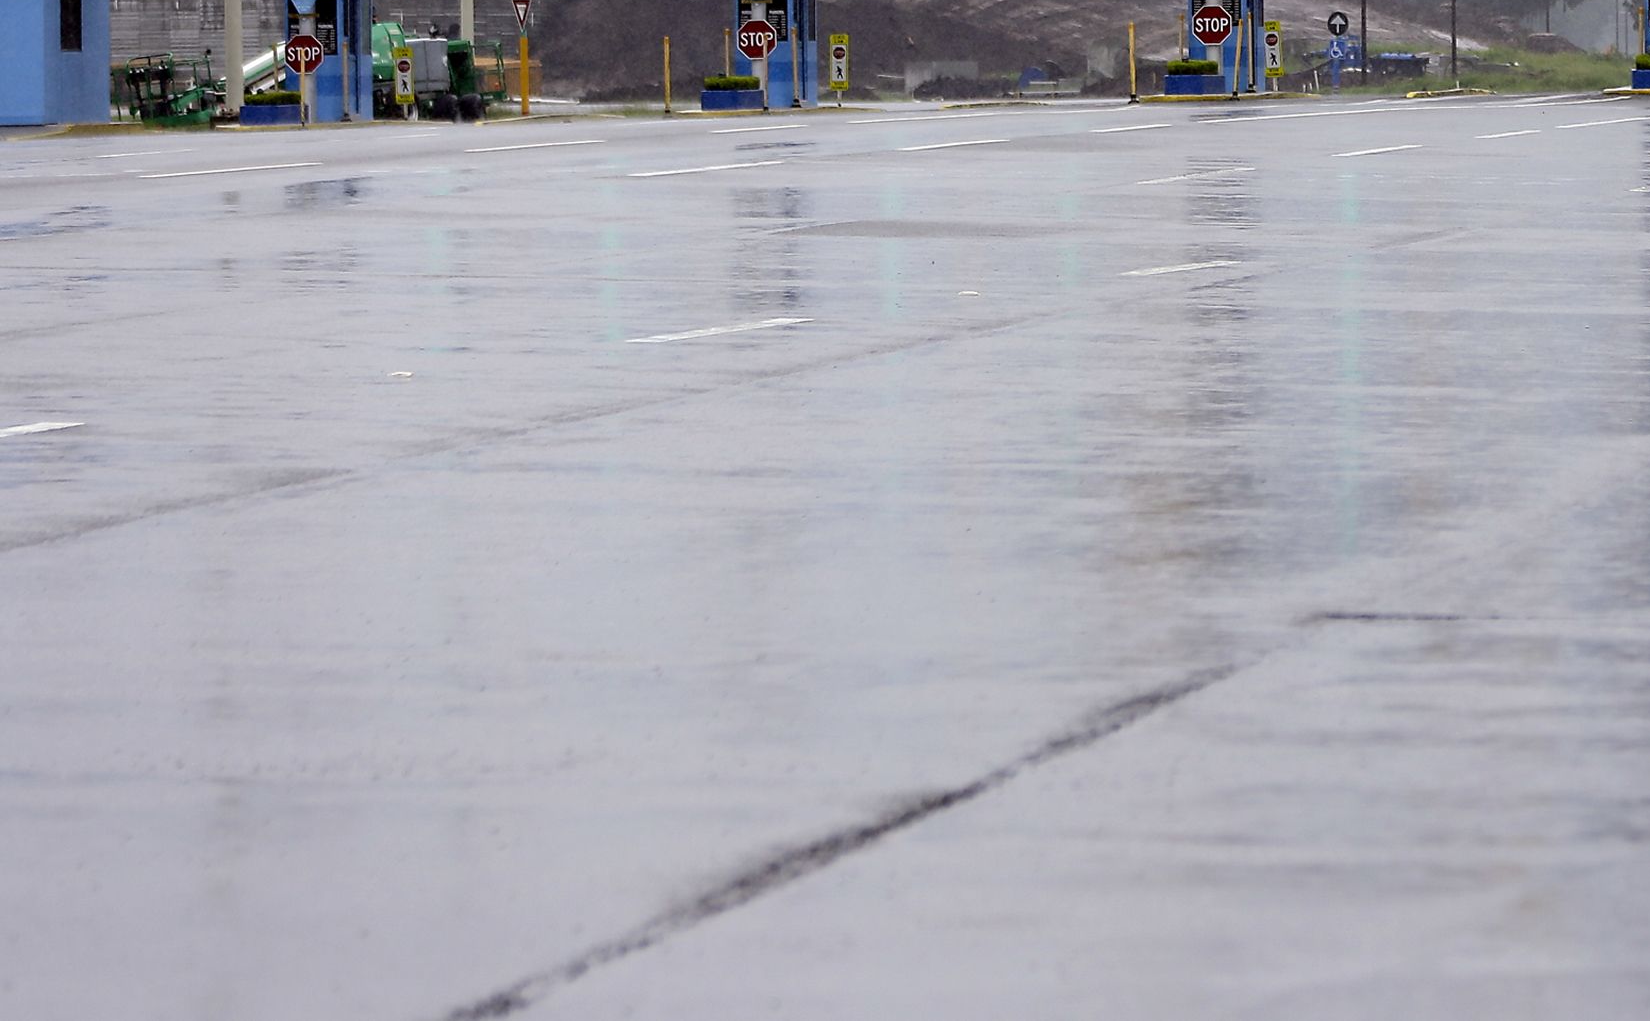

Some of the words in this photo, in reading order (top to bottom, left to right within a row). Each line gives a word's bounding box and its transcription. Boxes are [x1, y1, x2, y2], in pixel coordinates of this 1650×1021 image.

[1195, 17, 1229, 33] STOP
[740, 32, 773, 47] STOP
[287, 46, 320, 62] STOP
